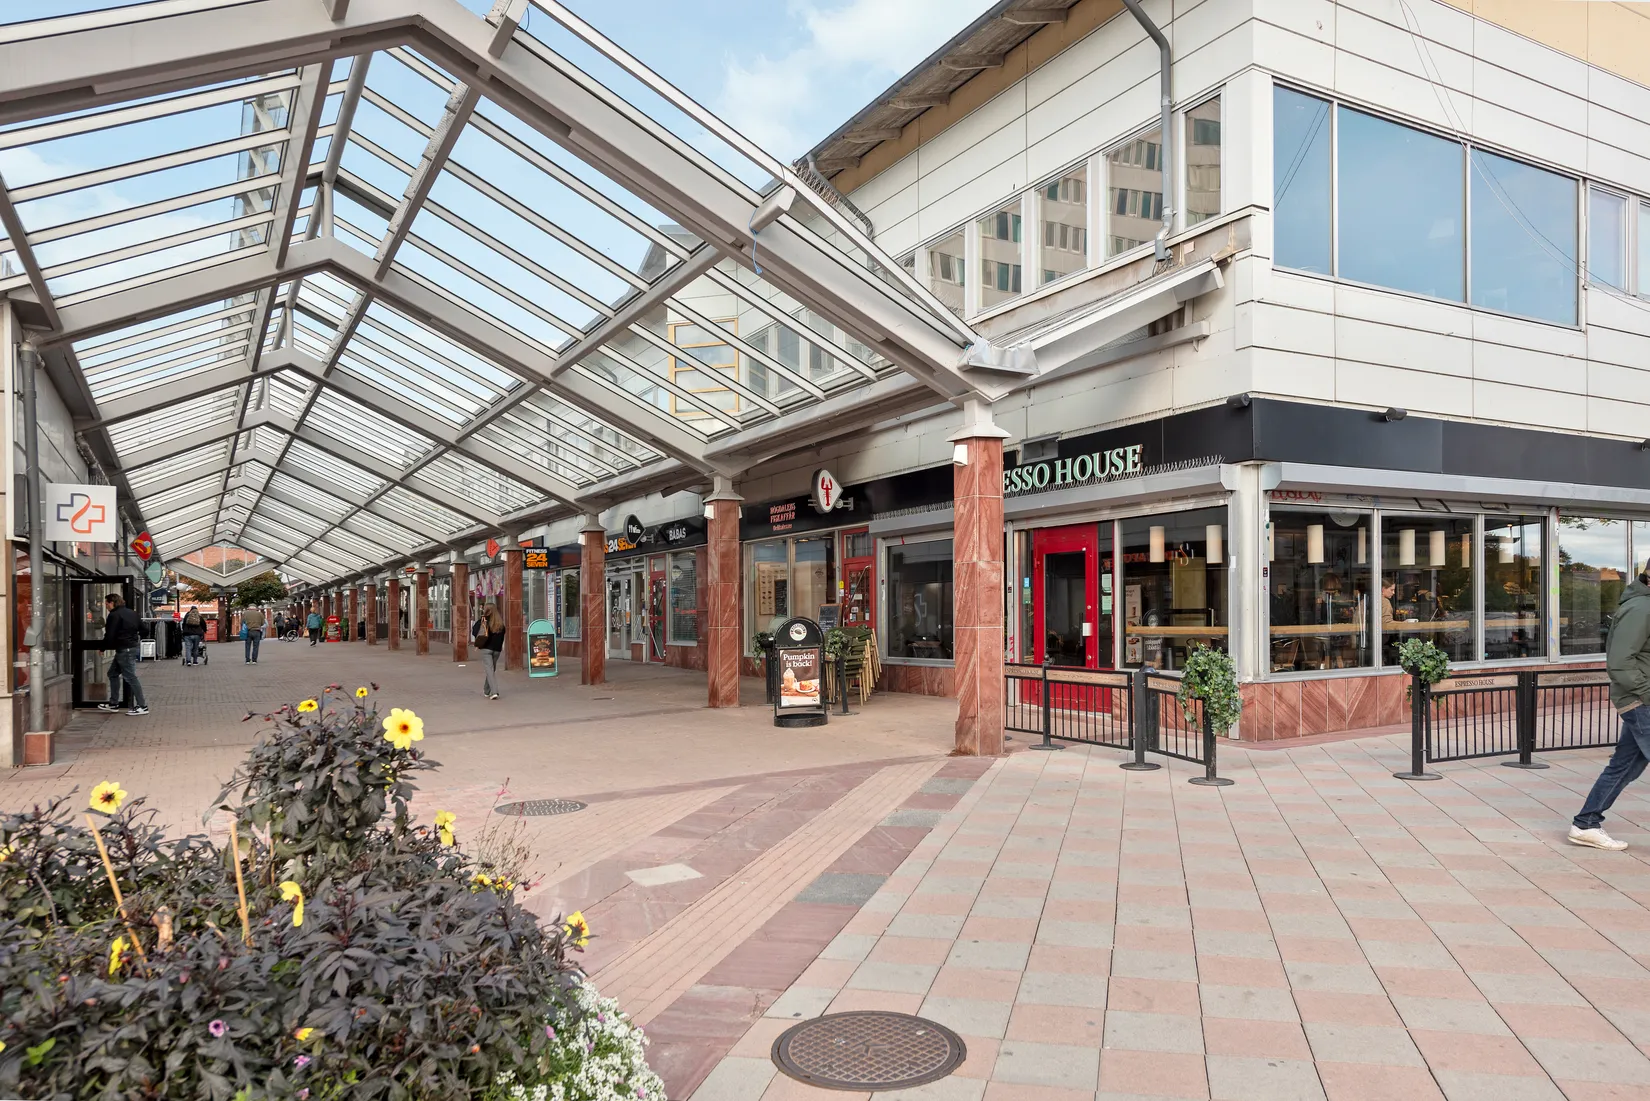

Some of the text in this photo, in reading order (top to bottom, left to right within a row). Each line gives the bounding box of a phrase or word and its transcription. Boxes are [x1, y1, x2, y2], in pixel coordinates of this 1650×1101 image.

[1054, 443, 1142, 485] HOUSE
[668, 528, 686, 540] BABAS
[608, 538, 618, 553] 24
[526, 553, 548, 562] 24
[783, 652, 815, 662] Pumpkin
[786, 660, 792, 668] is
[1454, 678, 1495, 688] ESPRESSO HOUSE
